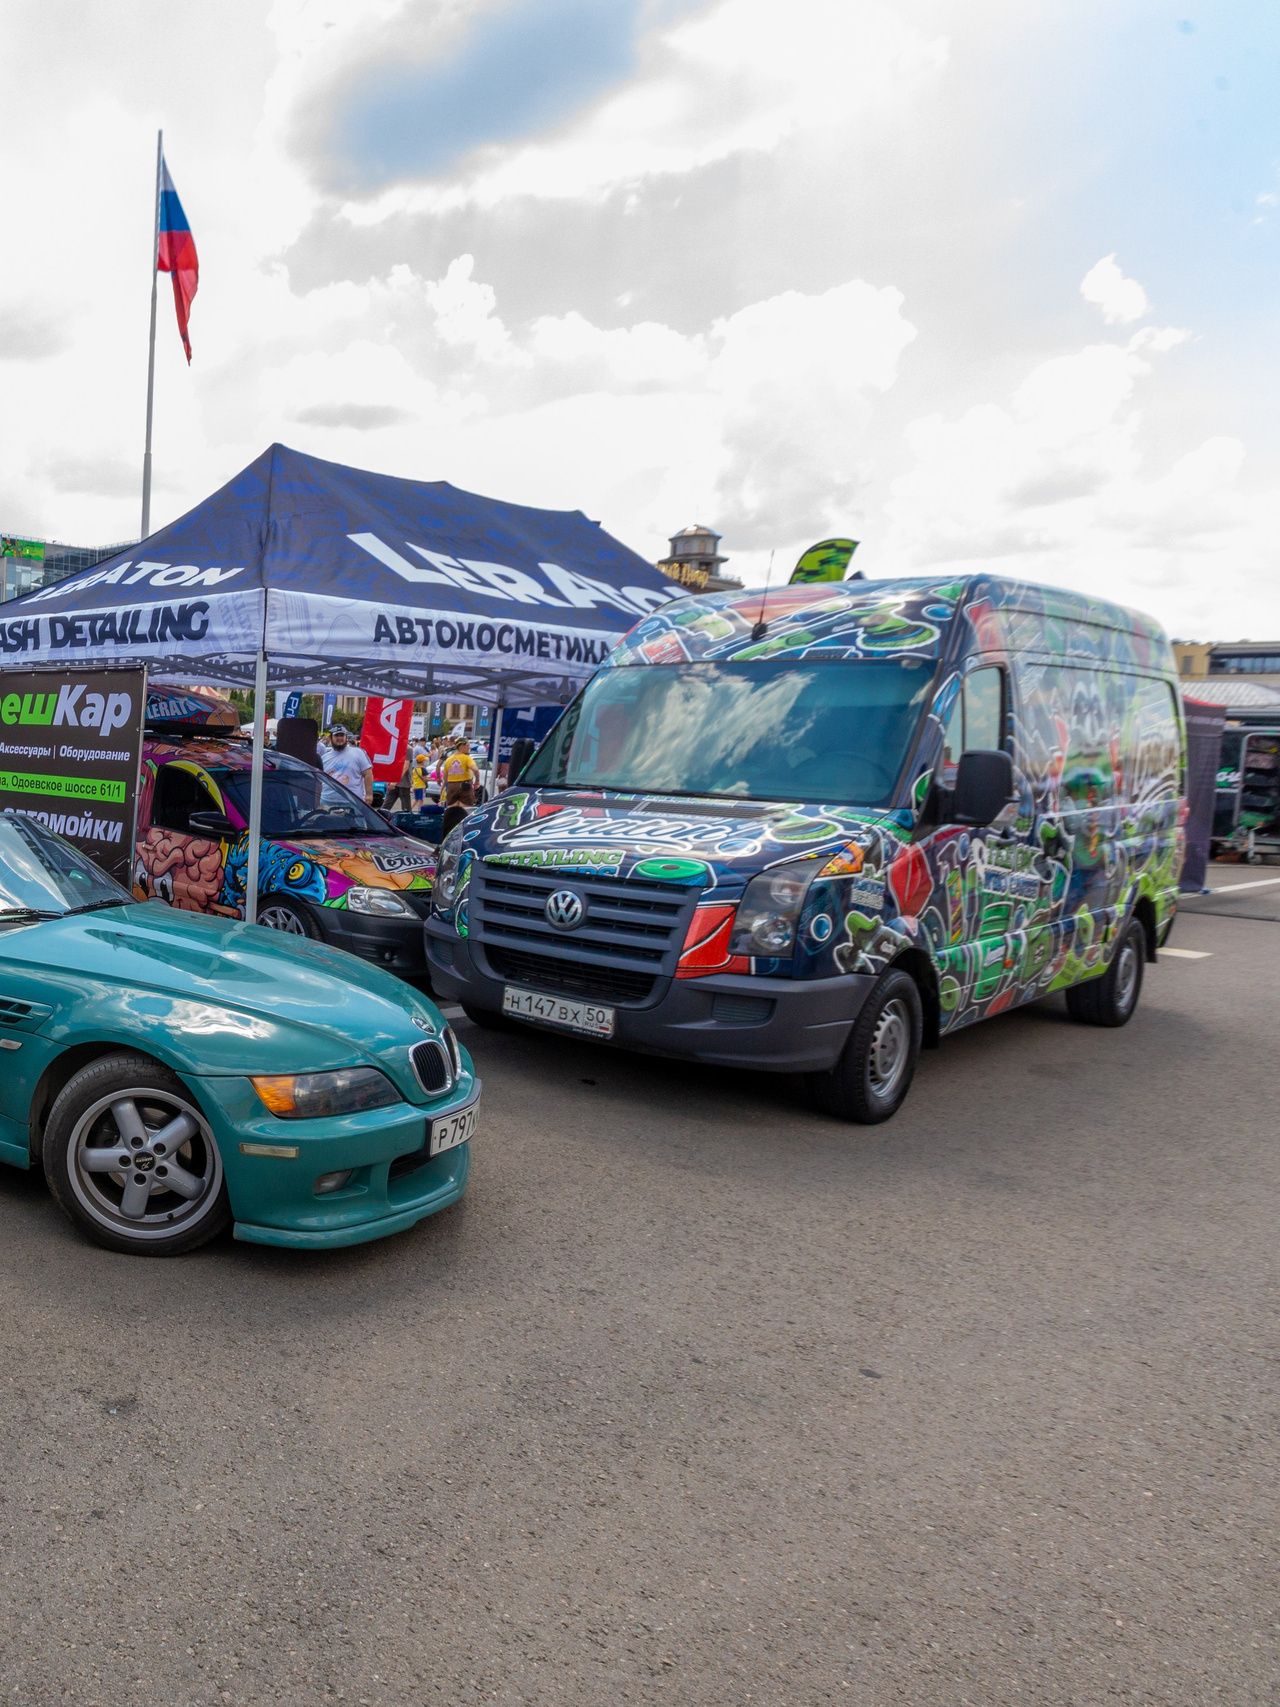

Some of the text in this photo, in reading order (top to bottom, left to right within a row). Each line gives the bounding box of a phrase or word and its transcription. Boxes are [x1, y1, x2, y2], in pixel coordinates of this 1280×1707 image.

[19, 561, 245, 605] LERATON
[347, 532, 693, 618] LERATO
[48, 600, 210, 648] DETAILING
[373, 614, 613, 664] АВТОКОСМЕТИКА
[59, 744, 131, 762] Оборудование
[11, 774, 62, 792] Одоевское
[65, 781, 97, 795] шоссе
[99, 782, 121, 798] 61/1
